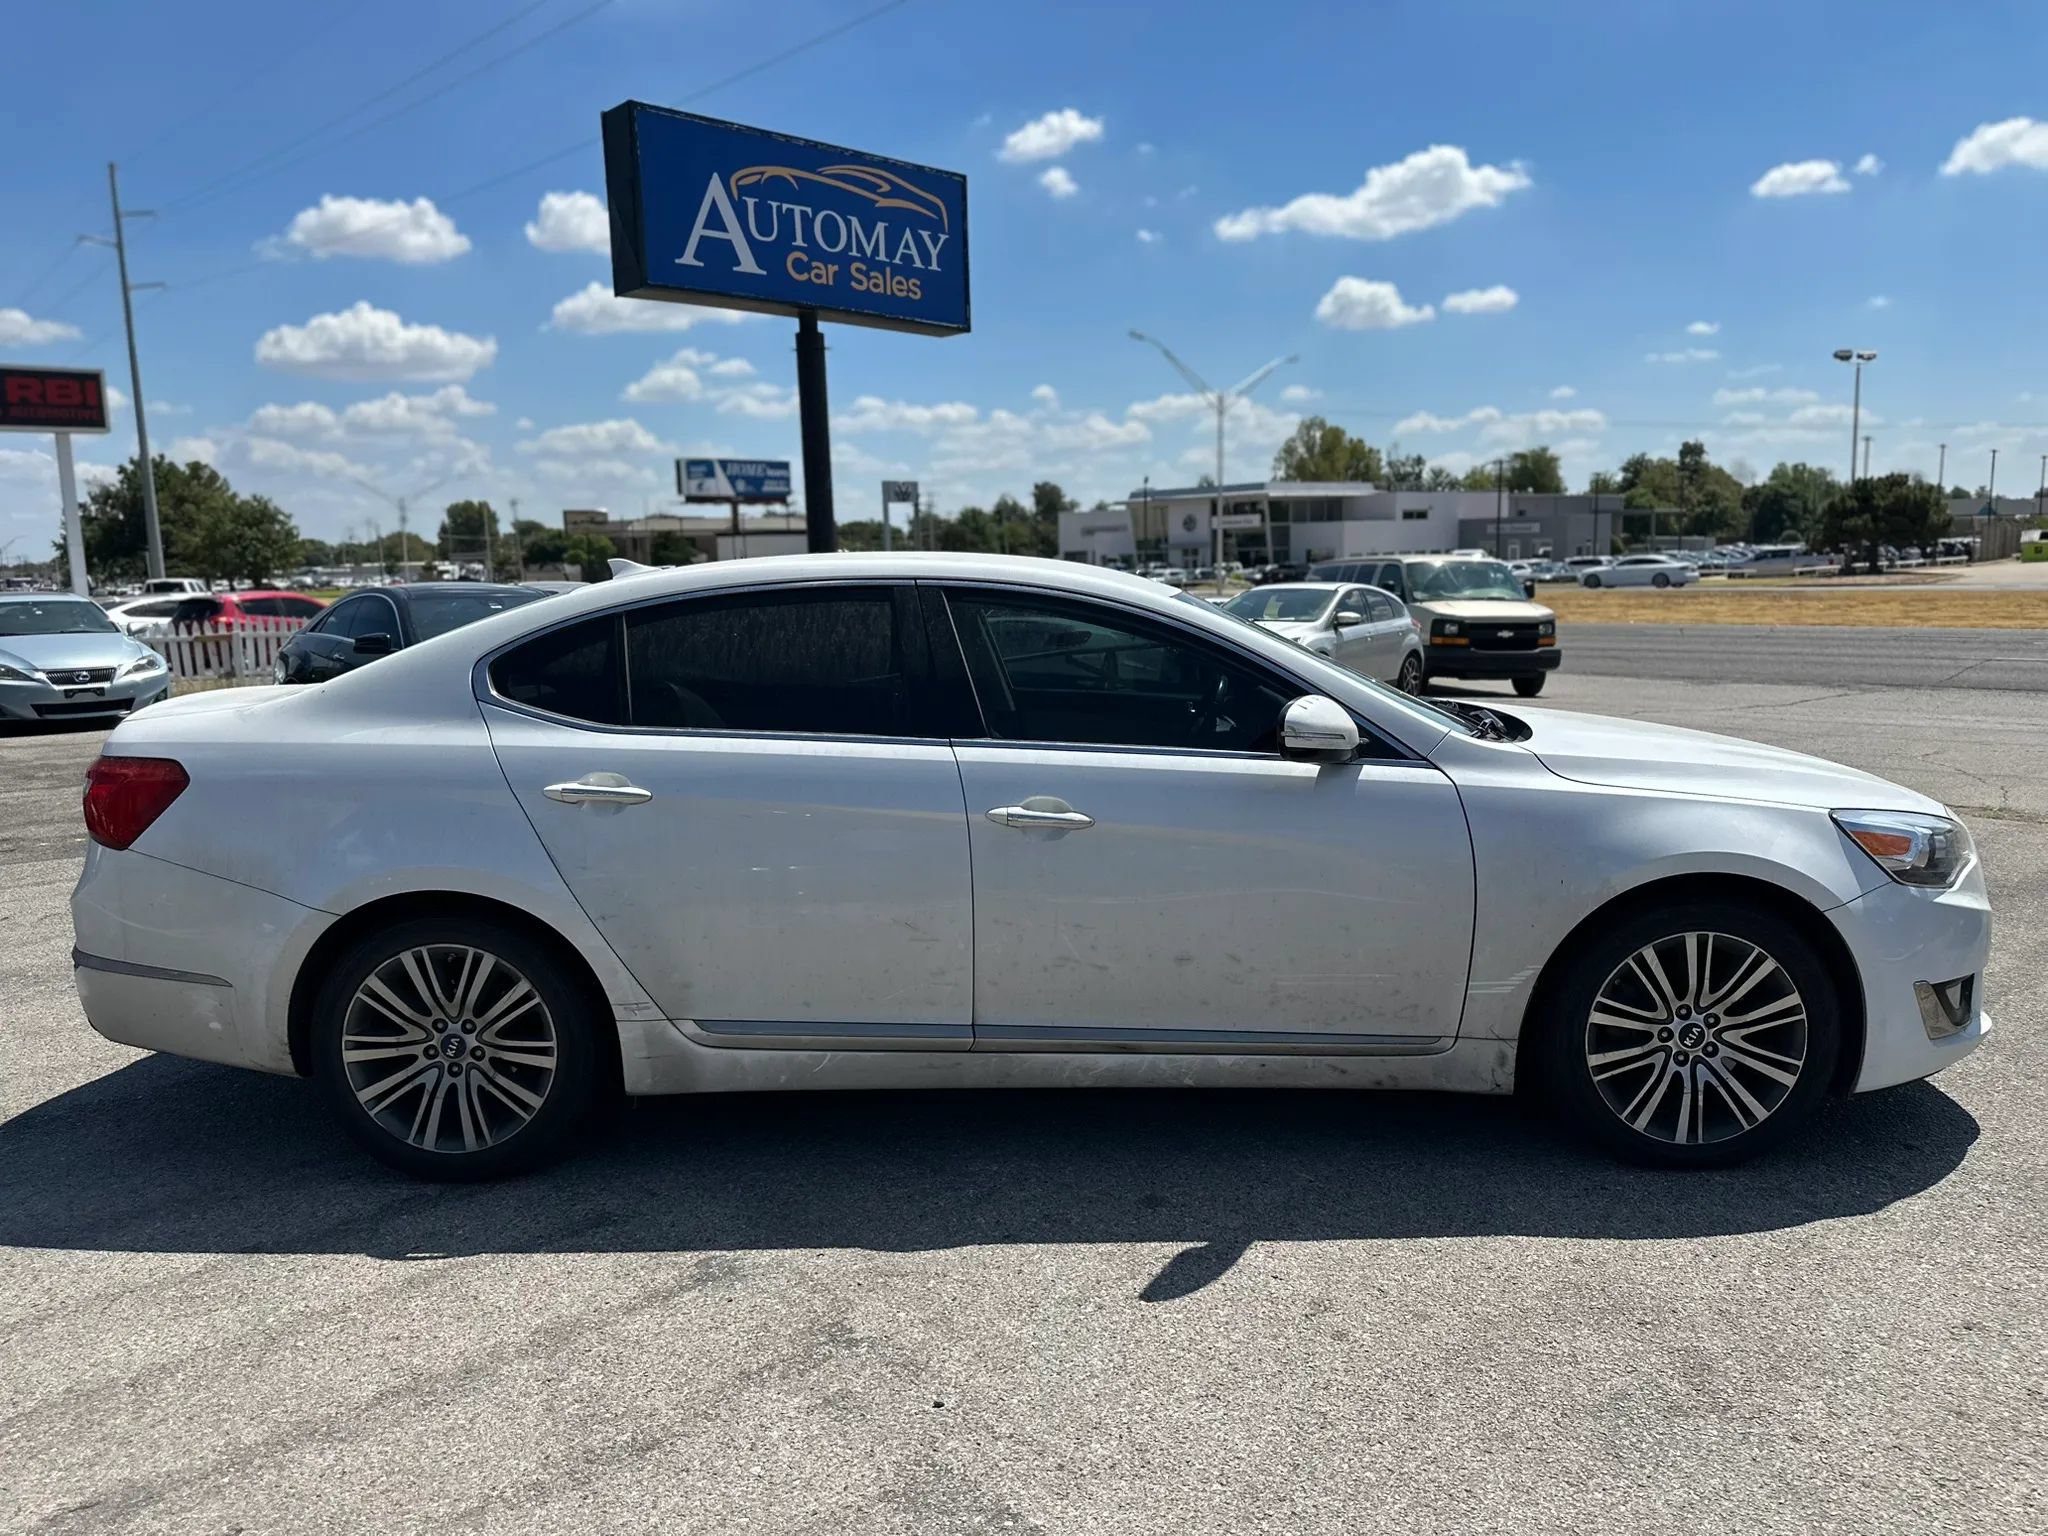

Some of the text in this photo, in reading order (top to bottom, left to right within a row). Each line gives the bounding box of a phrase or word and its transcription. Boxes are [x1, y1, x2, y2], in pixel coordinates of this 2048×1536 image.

[675, 172, 949, 275] AUTOMAY
[786, 251, 921, 300] Car Sales
[5, 376, 98, 406] RBI
[446, 1038, 460, 1057] KIA
[1683, 1027, 1701, 1047] KIA
